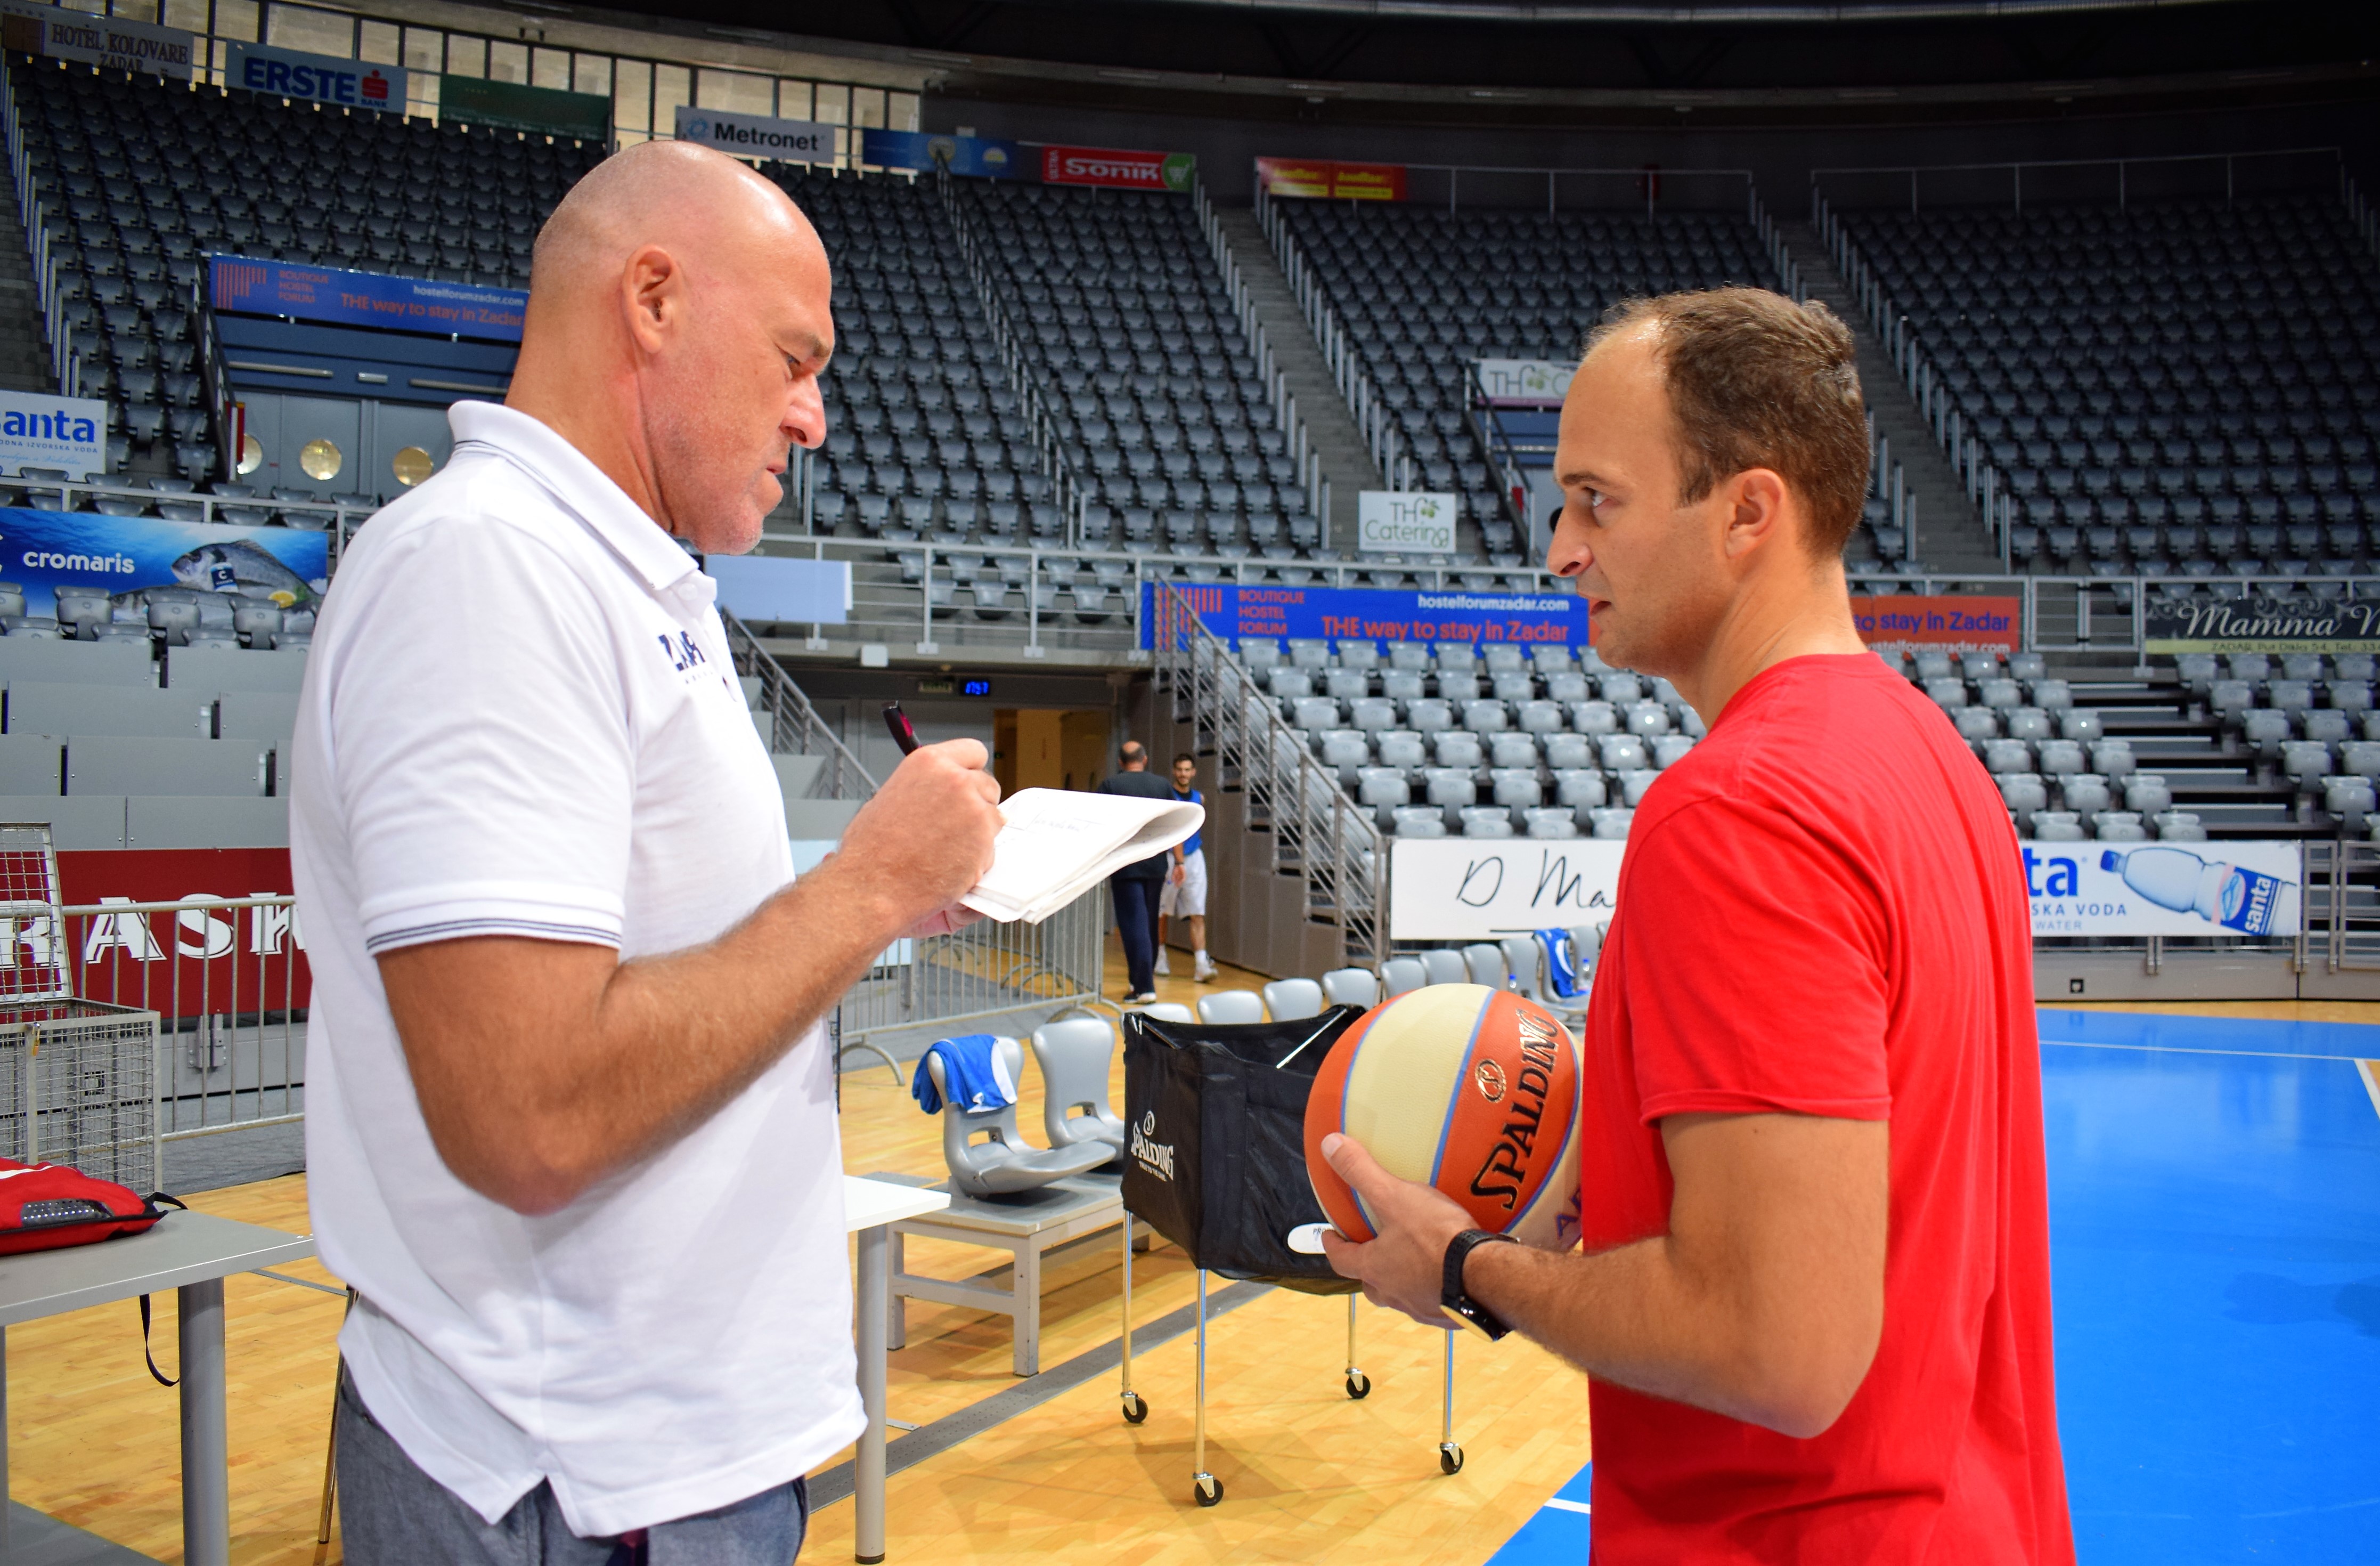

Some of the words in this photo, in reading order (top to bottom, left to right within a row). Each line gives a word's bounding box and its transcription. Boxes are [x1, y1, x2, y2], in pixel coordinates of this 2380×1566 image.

[52, 24, 104, 51] HOTEL
[108, 33, 188, 64] KOLOVARE
[100, 54, 143, 71] ZADAR
[244, 57, 356, 103] ERSTE
[714, 123, 818, 151] Metronet
[278, 291, 315, 303] FORUM
[279, 281, 313, 292] HOSTEL
[341, 293, 369, 310] THE
[373, 299, 406, 317] way
[409, 303, 425, 316] to
[428, 305, 459, 321] stay
[462, 306, 475, 320] in
[479, 309, 524, 326] Zadar
[0, 410, 95, 443] anta
[1365, 519, 1449, 548] Catering
[23, 551, 135, 574] cromaris
[1238, 590, 1305, 604] BOUTIQUE
[1418, 595, 1569, 611] hostelforumzadar.com
[1238, 606, 1285, 619] HOSTEL
[1854, 615, 1876, 631] to
[1880, 613, 1922, 634] stay
[1927, 611, 1944, 630] in
[1949, 611, 2010, 631] Zadar
[2178, 604, 2342, 636] Mamma
[1238, 622, 1287, 635] FORUM
[1322, 616, 1359, 637] THE
[1364, 621, 1409, 642] way
[1413, 621, 1436, 638] to
[1440, 621, 1482, 644] stay
[1486, 620, 1503, 640] in
[1507, 621, 1569, 642] Zadar
[1868, 639, 2010, 653] ostelforumzadar.com
[1456, 857, 1503, 906] D
[1531, 848, 1616, 908] Ma
[2023, 848, 2078, 897] ta
[2032, 903, 2065, 916] SKA
[2076, 903, 2126, 916] VODA
[2245, 877, 2272, 932] santa
[2035, 920, 2082, 930] WATER
[1470, 1008, 1559, 1211] SPALDING
[1131, 1121, 1173, 1181] SPALDING
